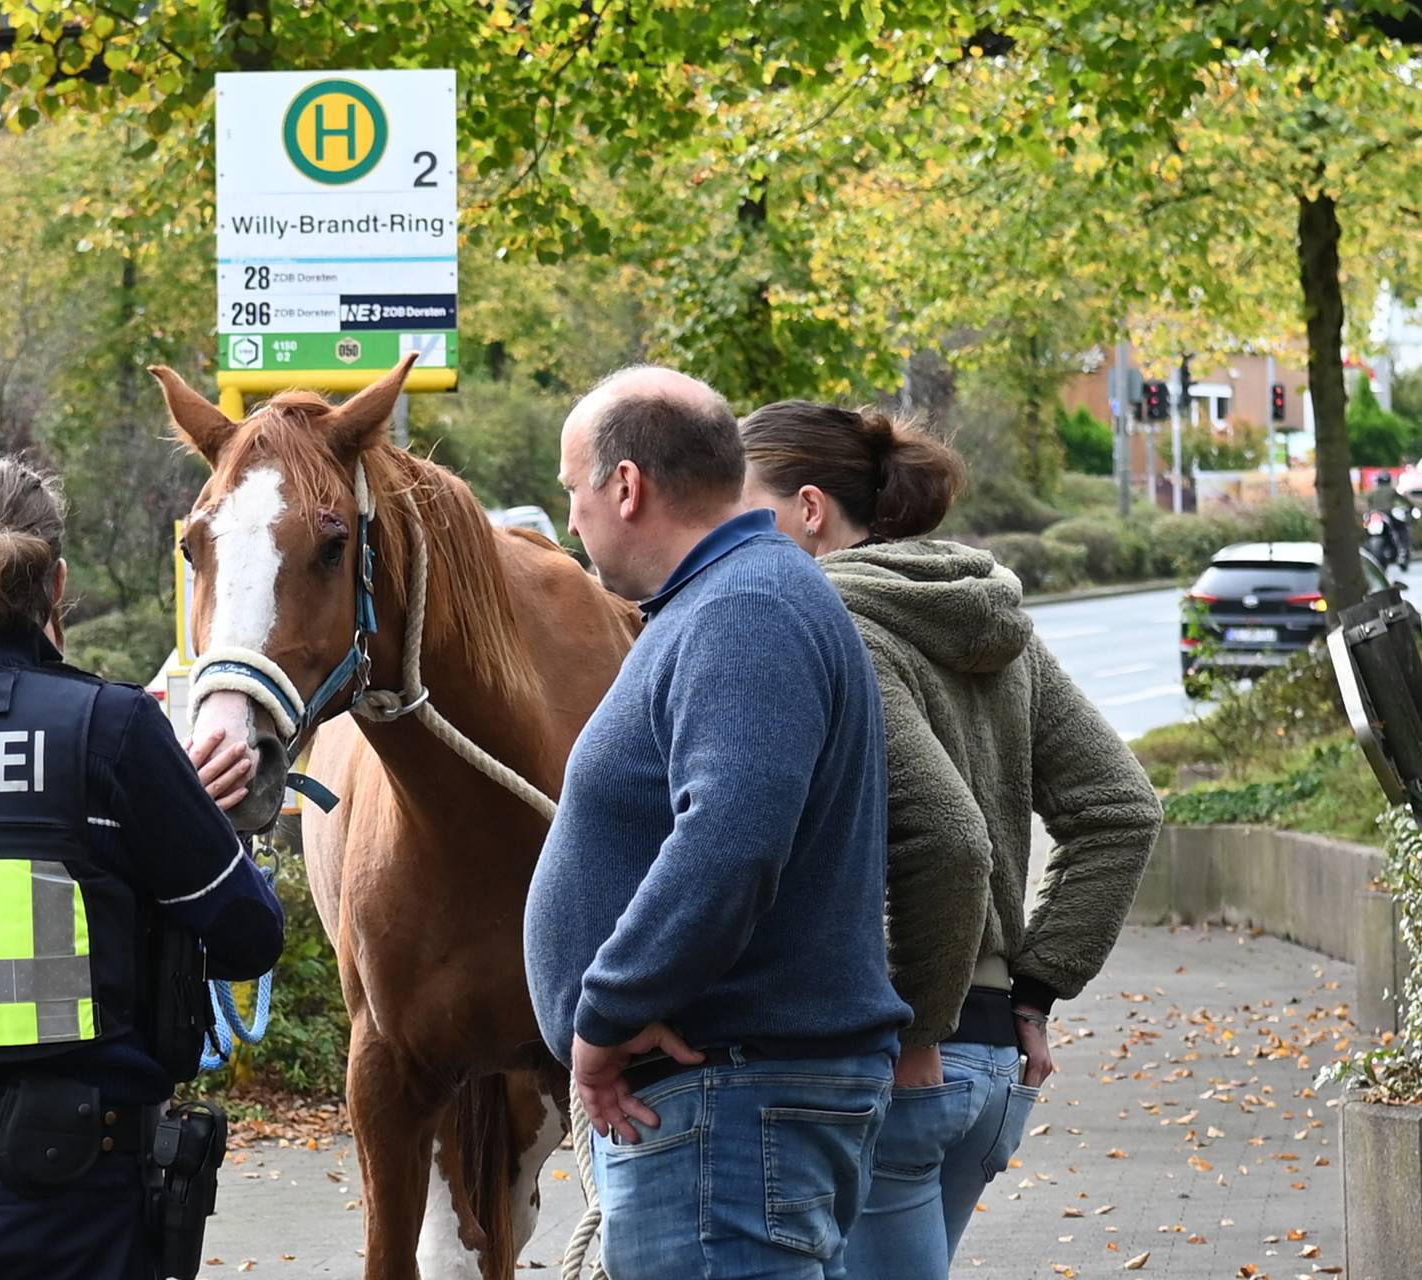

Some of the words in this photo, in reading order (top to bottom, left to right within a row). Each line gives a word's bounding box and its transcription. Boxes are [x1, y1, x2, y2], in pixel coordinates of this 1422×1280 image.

[315, 103, 356, 161] H
[413, 151, 438, 188] 2
[231, 213, 445, 239] Willy-Brandt-Ring
[244, 265, 271, 290] 28
[231, 301, 271, 326] 296
[406, 305, 447, 317] Dorsten
